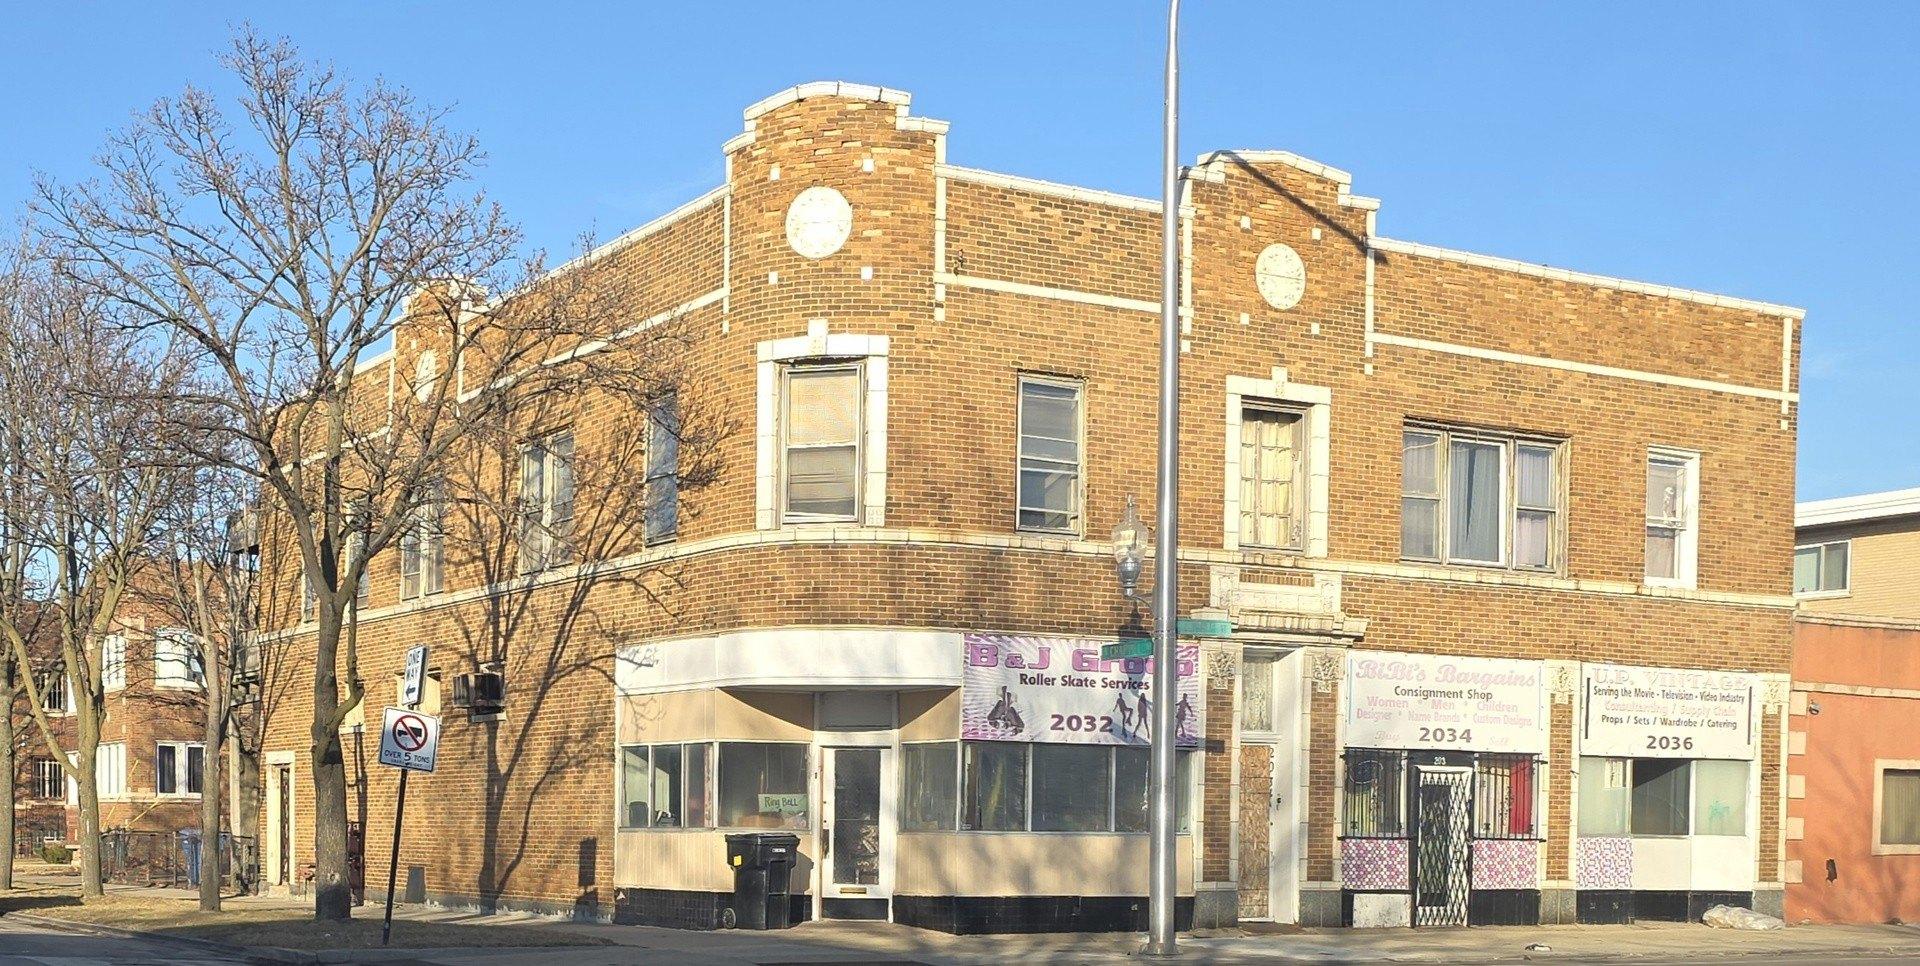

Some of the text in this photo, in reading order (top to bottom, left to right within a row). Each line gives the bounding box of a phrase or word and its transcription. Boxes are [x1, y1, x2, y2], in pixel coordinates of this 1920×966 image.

[407, 650, 421, 667] ONE
[969, 643, 1050, 670] B&J
[1071, 648, 1194, 677] Grop
[1019, 673, 1150, 690] Roller Skate Services
[1435, 664, 1535, 690] Bargains
[1394, 685, 1493, 701] Consignment Shop
[1593, 685, 1745, 704] Serving the Movie Television Video Industry
[1366, 696, 1518, 712] Women Men Children
[1050, 714, 1114, 733] 2032
[1356, 709, 1532, 728] Designer Name Brands Custom Designs
[1601, 715, 1623, 725] Props
[1634, 716, 1650, 726] Sets
[1660, 717, 1697, 727] Wardrobe
[1707, 719, 1737, 730] Catering
[1418, 727, 1472, 743] 2034
[1646, 736, 1694, 750] 2036
[384, 749, 402, 759] OVER
[404, 752, 412, 761] 5
[414, 754, 431, 764] TONS
[764, 796, 781, 809] Ring
